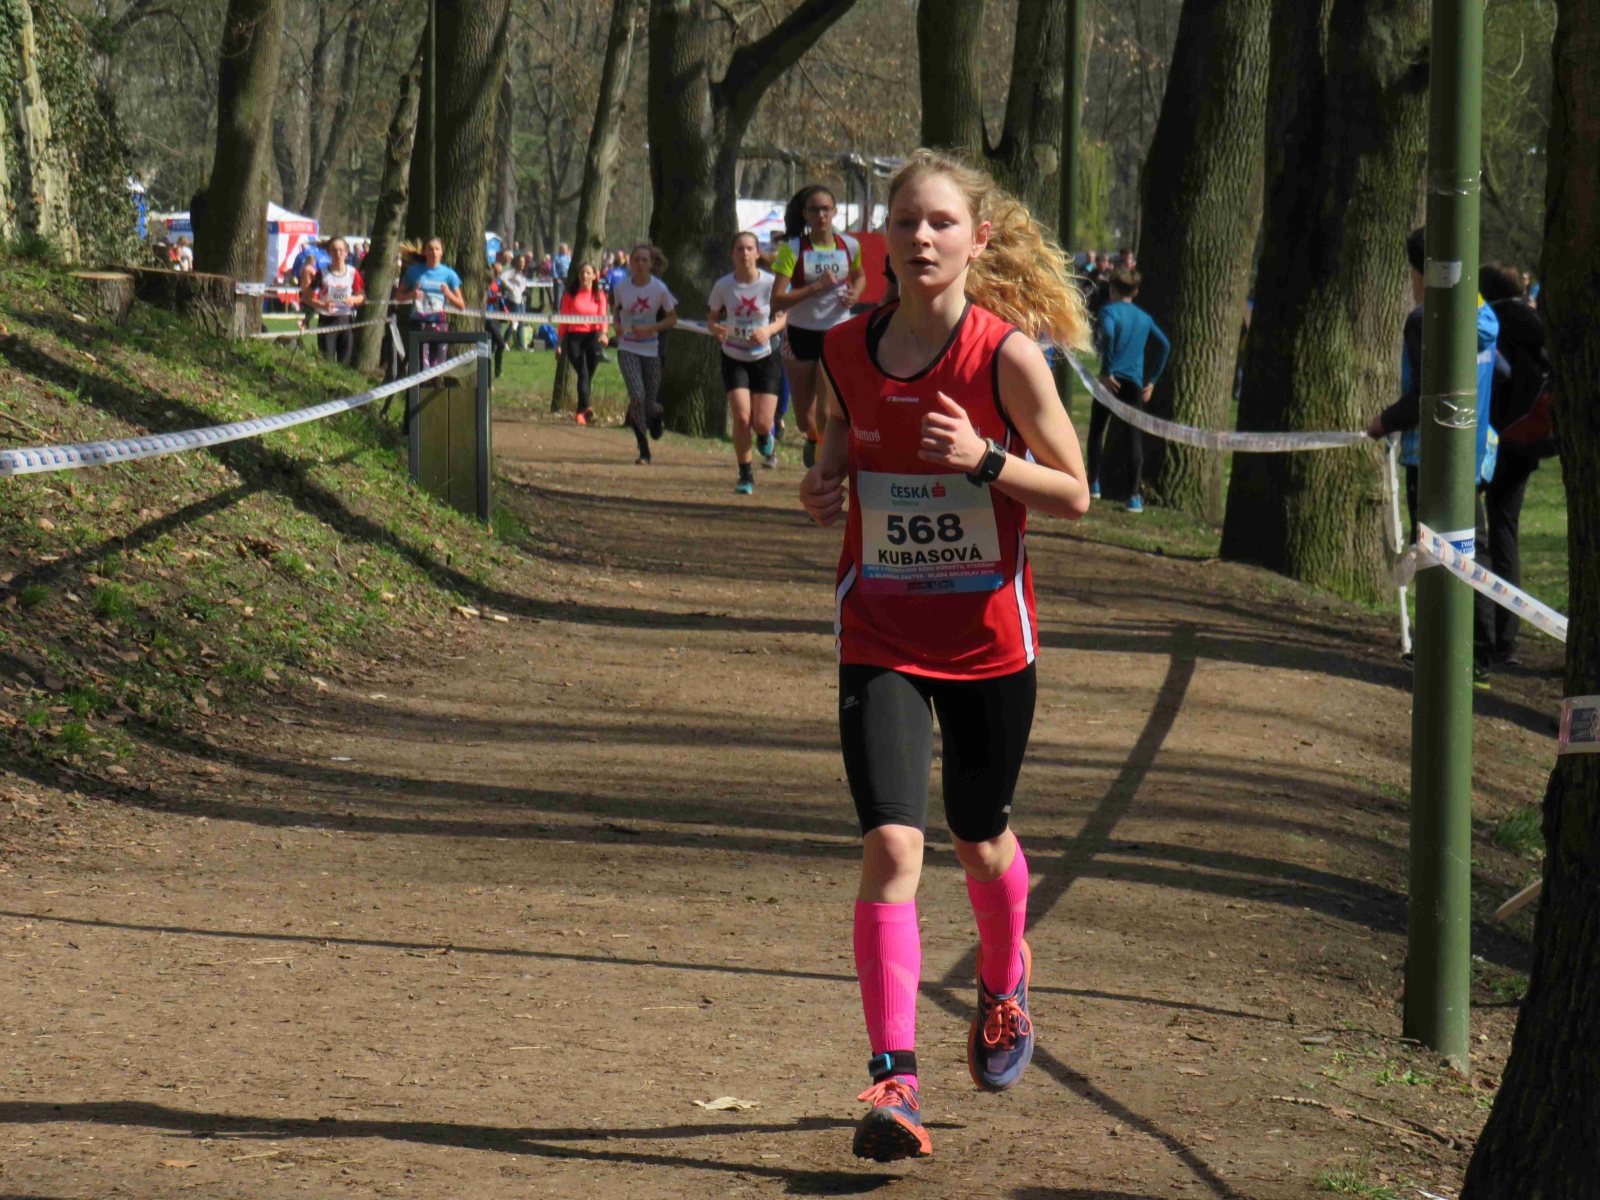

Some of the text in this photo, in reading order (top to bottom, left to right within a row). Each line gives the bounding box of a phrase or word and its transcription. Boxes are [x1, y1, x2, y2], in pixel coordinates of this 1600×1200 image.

[890, 482, 930, 499] ČESKÁ
[886, 513, 964, 546] 568
[877, 543, 983, 566] KUBASOVÁ
